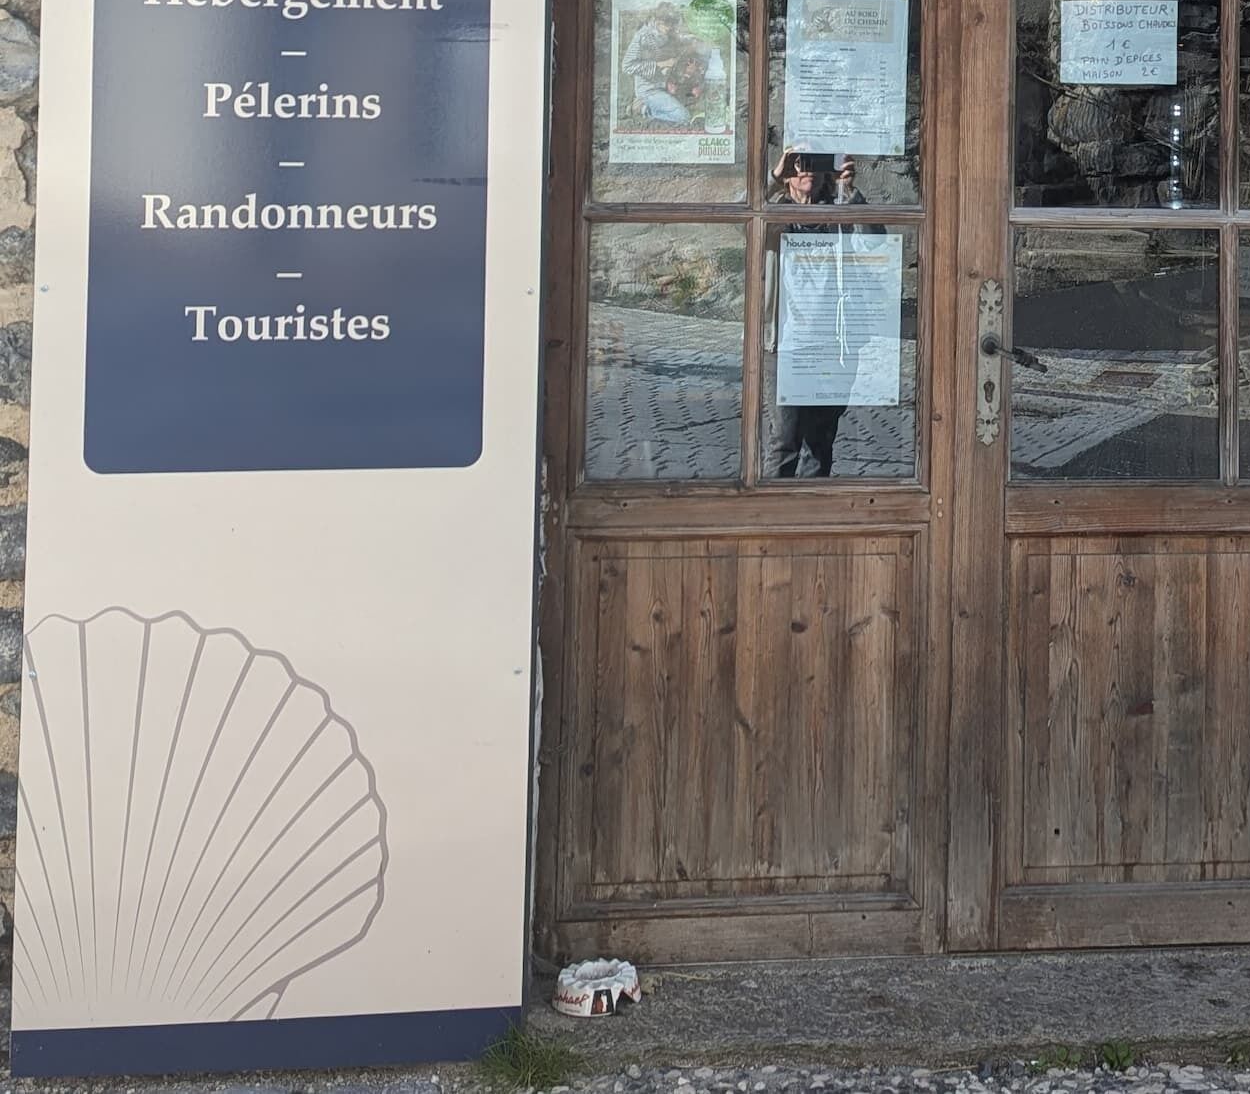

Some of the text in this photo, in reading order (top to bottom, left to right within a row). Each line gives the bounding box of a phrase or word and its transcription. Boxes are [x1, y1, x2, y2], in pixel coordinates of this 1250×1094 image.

[1080, 56, 1110, 66] PAIN
[1082, 70, 1122, 80] MAISON
[203, 82, 381, 119] Pélerins
[141, 193, 437, 230] Randonneurs
[185, 305, 390, 341] Touristes
